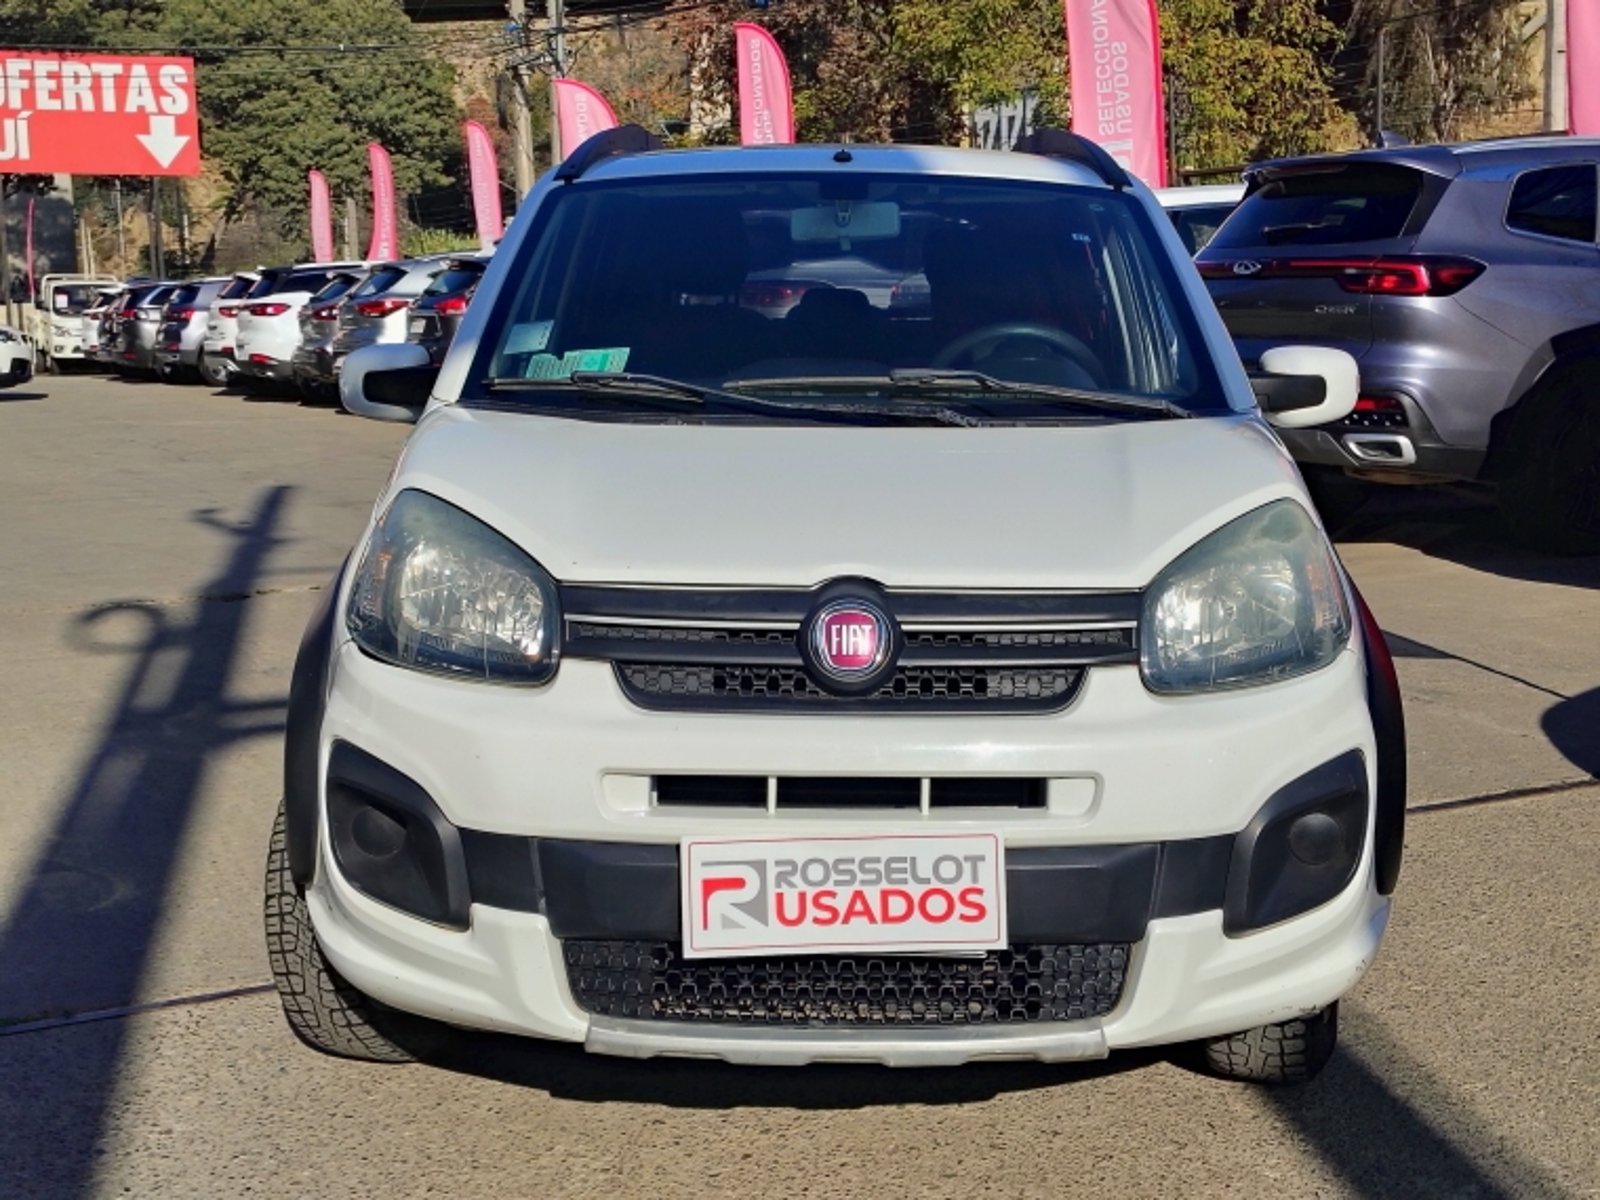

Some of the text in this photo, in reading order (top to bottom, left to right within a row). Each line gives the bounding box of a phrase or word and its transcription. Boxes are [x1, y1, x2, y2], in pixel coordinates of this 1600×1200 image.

[0, 58, 189, 115] FERTAS
[831, 624, 873, 656] FIAT
[774, 855, 986, 889] ROSSELOT
[775, 886, 987, 927] USADOS
